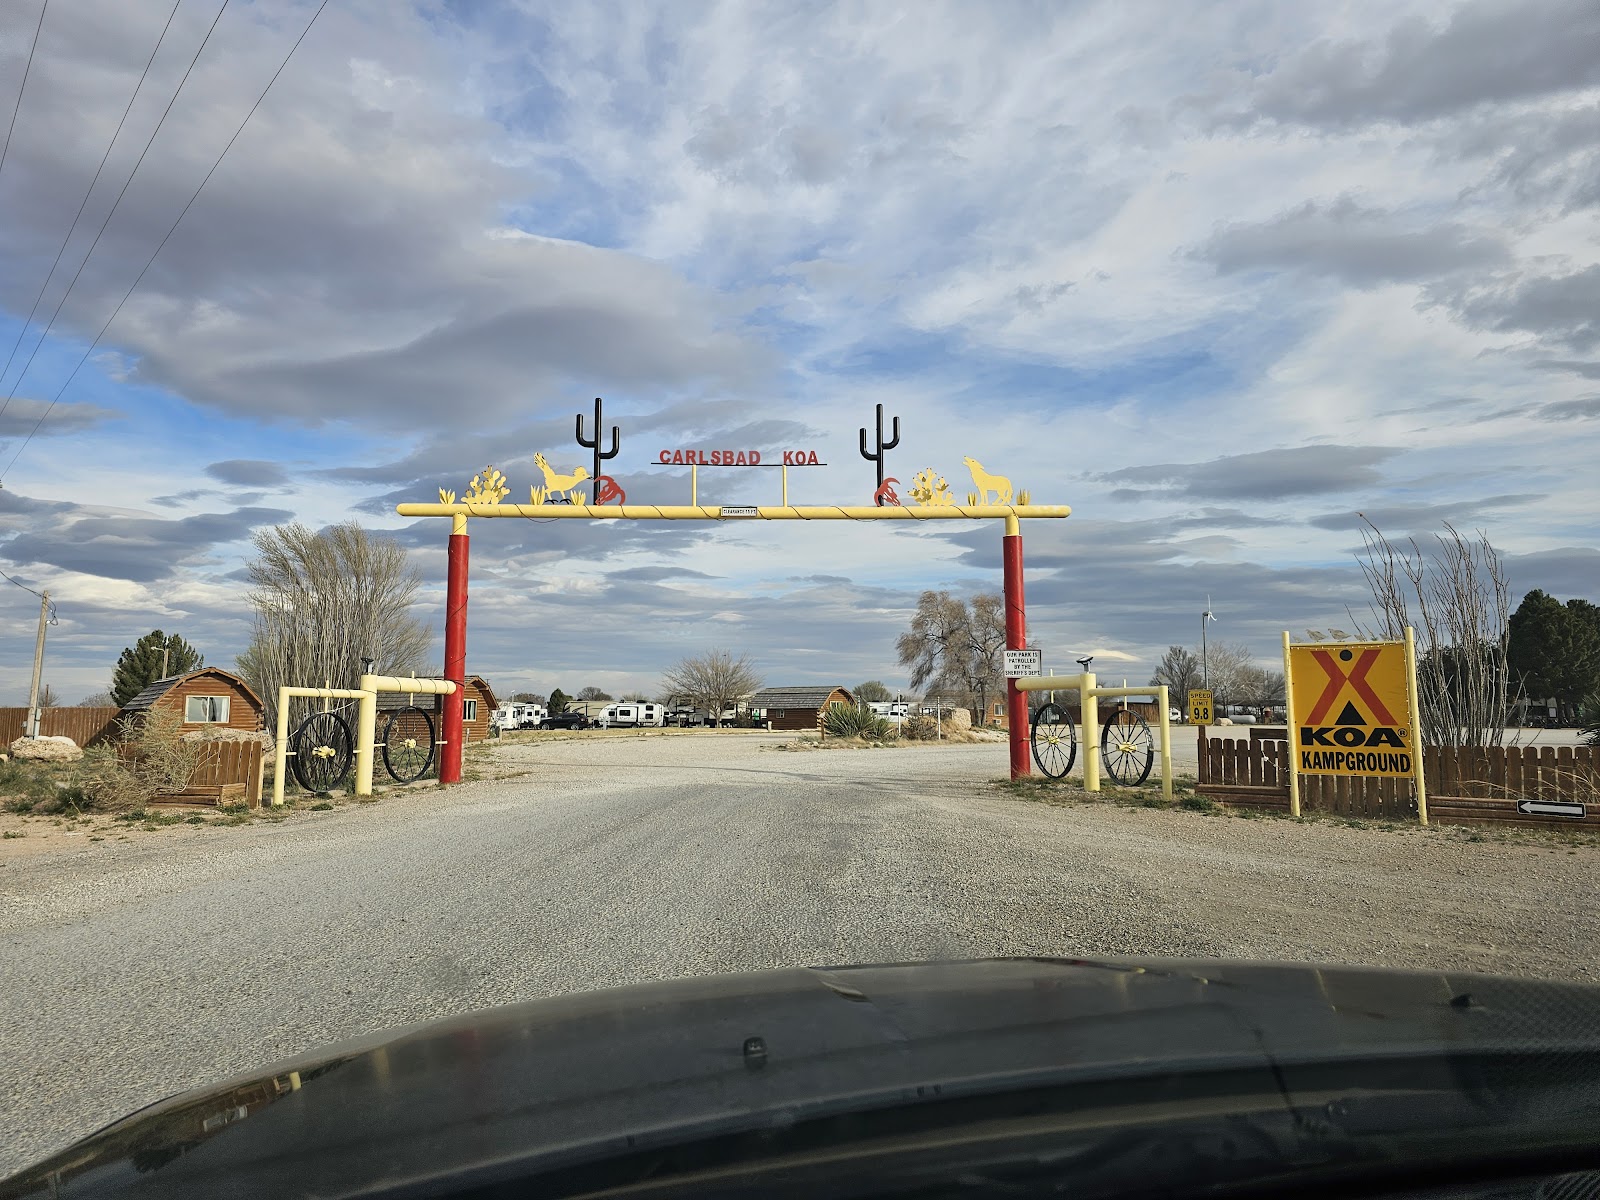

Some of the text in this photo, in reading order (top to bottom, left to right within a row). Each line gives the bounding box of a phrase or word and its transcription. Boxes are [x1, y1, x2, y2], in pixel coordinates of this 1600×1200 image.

[659, 449, 818, 465] CARLSBAD KOA
[1194, 707, 1209, 720] 9.8
[1301, 751, 1411, 773] KAMPGROUND
